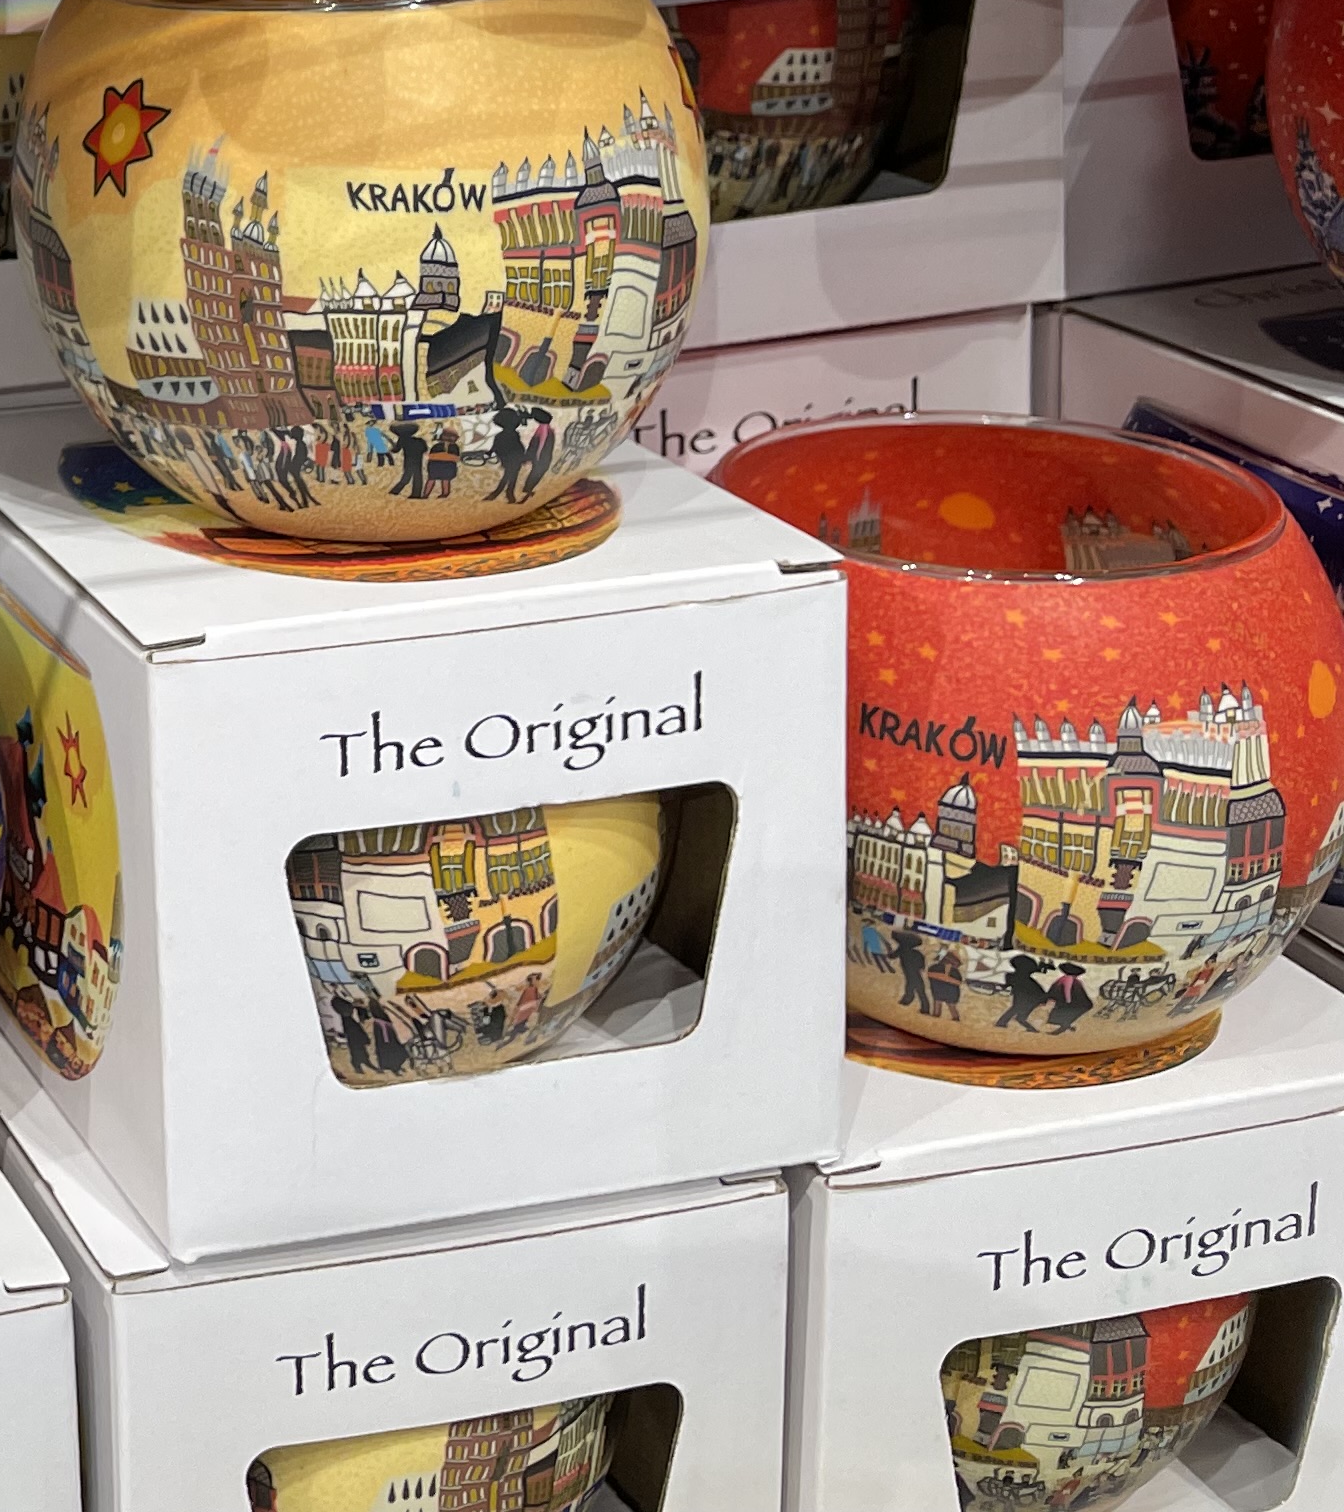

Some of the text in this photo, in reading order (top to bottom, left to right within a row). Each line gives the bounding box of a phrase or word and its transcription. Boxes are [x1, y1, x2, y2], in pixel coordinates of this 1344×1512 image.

[346, 167, 487, 213] KRAKÓW
[320, 669, 703, 778] The Original
[859, 702, 1007, 769] KRAKÓW
[976, 1180, 1319, 1292] The Original
[275, 1282, 646, 1397] The Original
